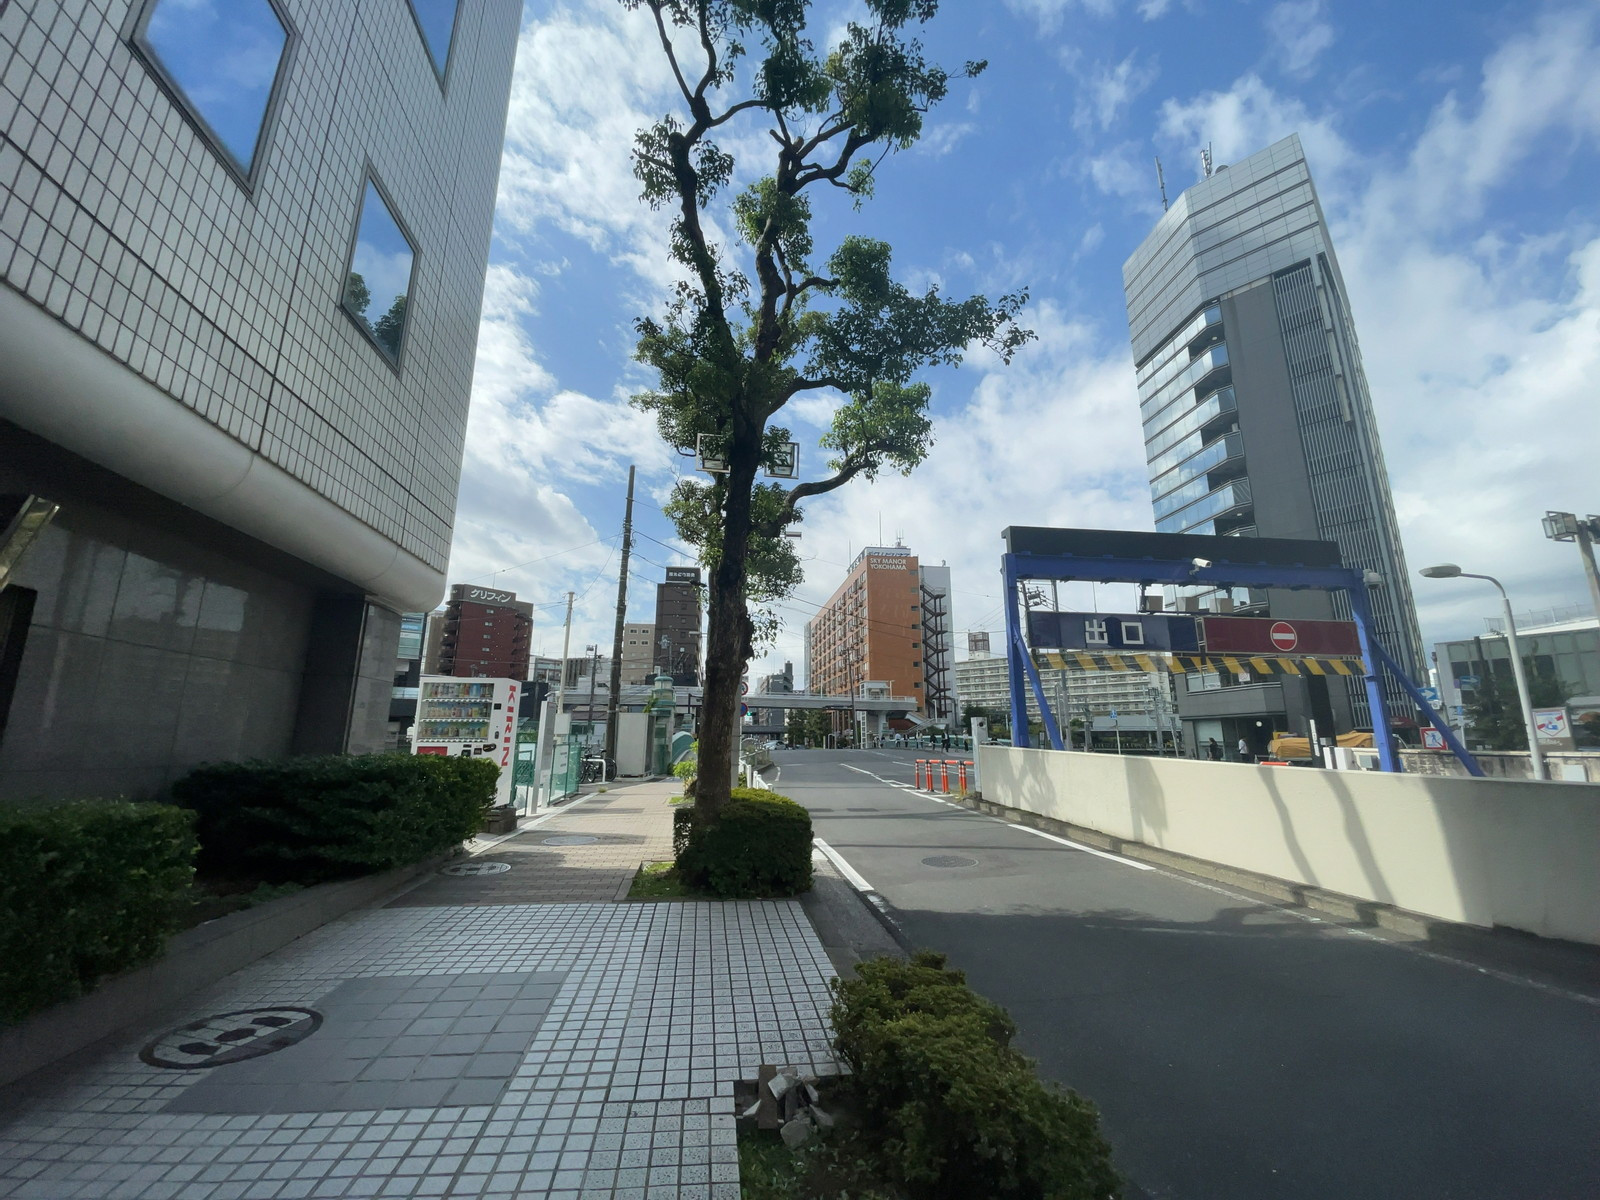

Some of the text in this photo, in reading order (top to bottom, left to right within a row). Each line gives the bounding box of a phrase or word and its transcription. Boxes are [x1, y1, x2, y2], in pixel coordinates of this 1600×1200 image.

[470, 588, 511, 603] グリフィン
[1085, 618, 1145, 645] 出口
[501, 685, 517, 766] KIRIN
